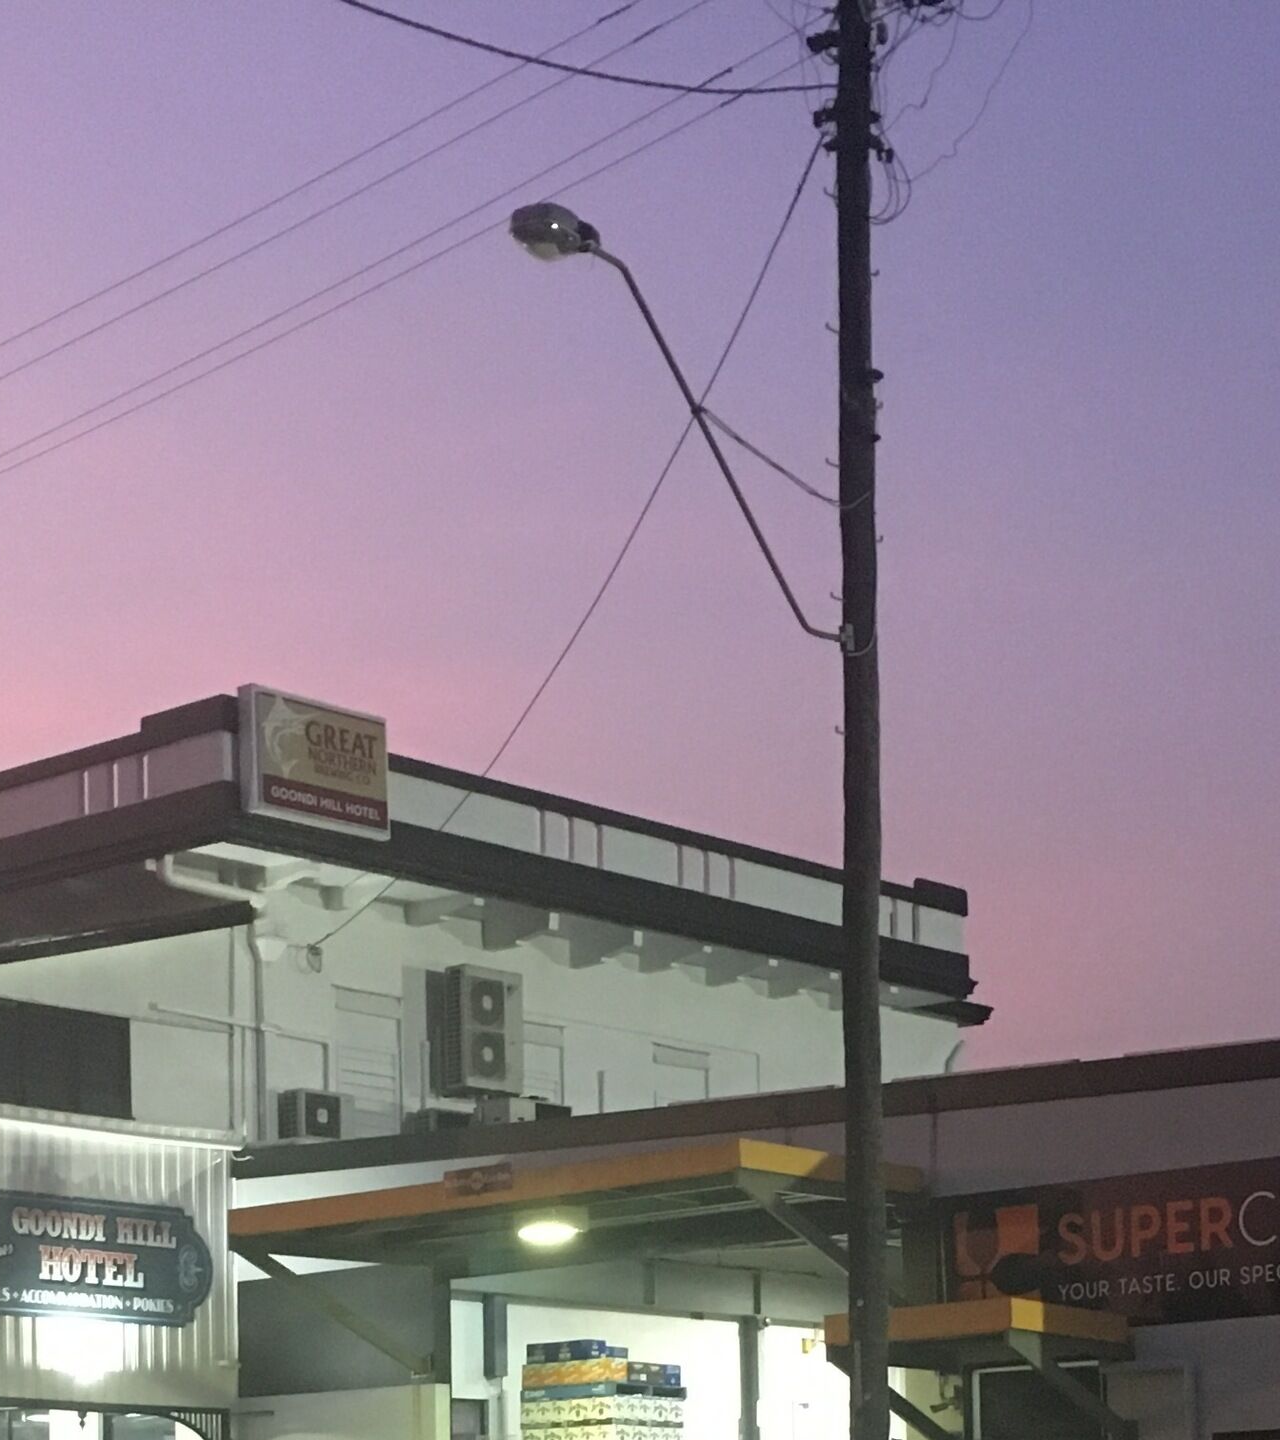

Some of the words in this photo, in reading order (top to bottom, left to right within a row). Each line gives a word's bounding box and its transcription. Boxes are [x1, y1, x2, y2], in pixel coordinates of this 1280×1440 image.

[305, 720, 378, 759] GREAT
[271, 785, 318, 806] GOONDI
[319, 796, 343, 813] HILL
[345, 803, 381, 821] HOTEL
[11, 1206, 107, 1243] GOONDI
[116, 1216, 177, 1249] HILL
[38, 1244, 145, 1289] HOTEL
[1058, 1281, 1110, 1302] YOUR
[1188, 1268, 1231, 1291] OUR
[132, 1296, 175, 1313] POKIES
